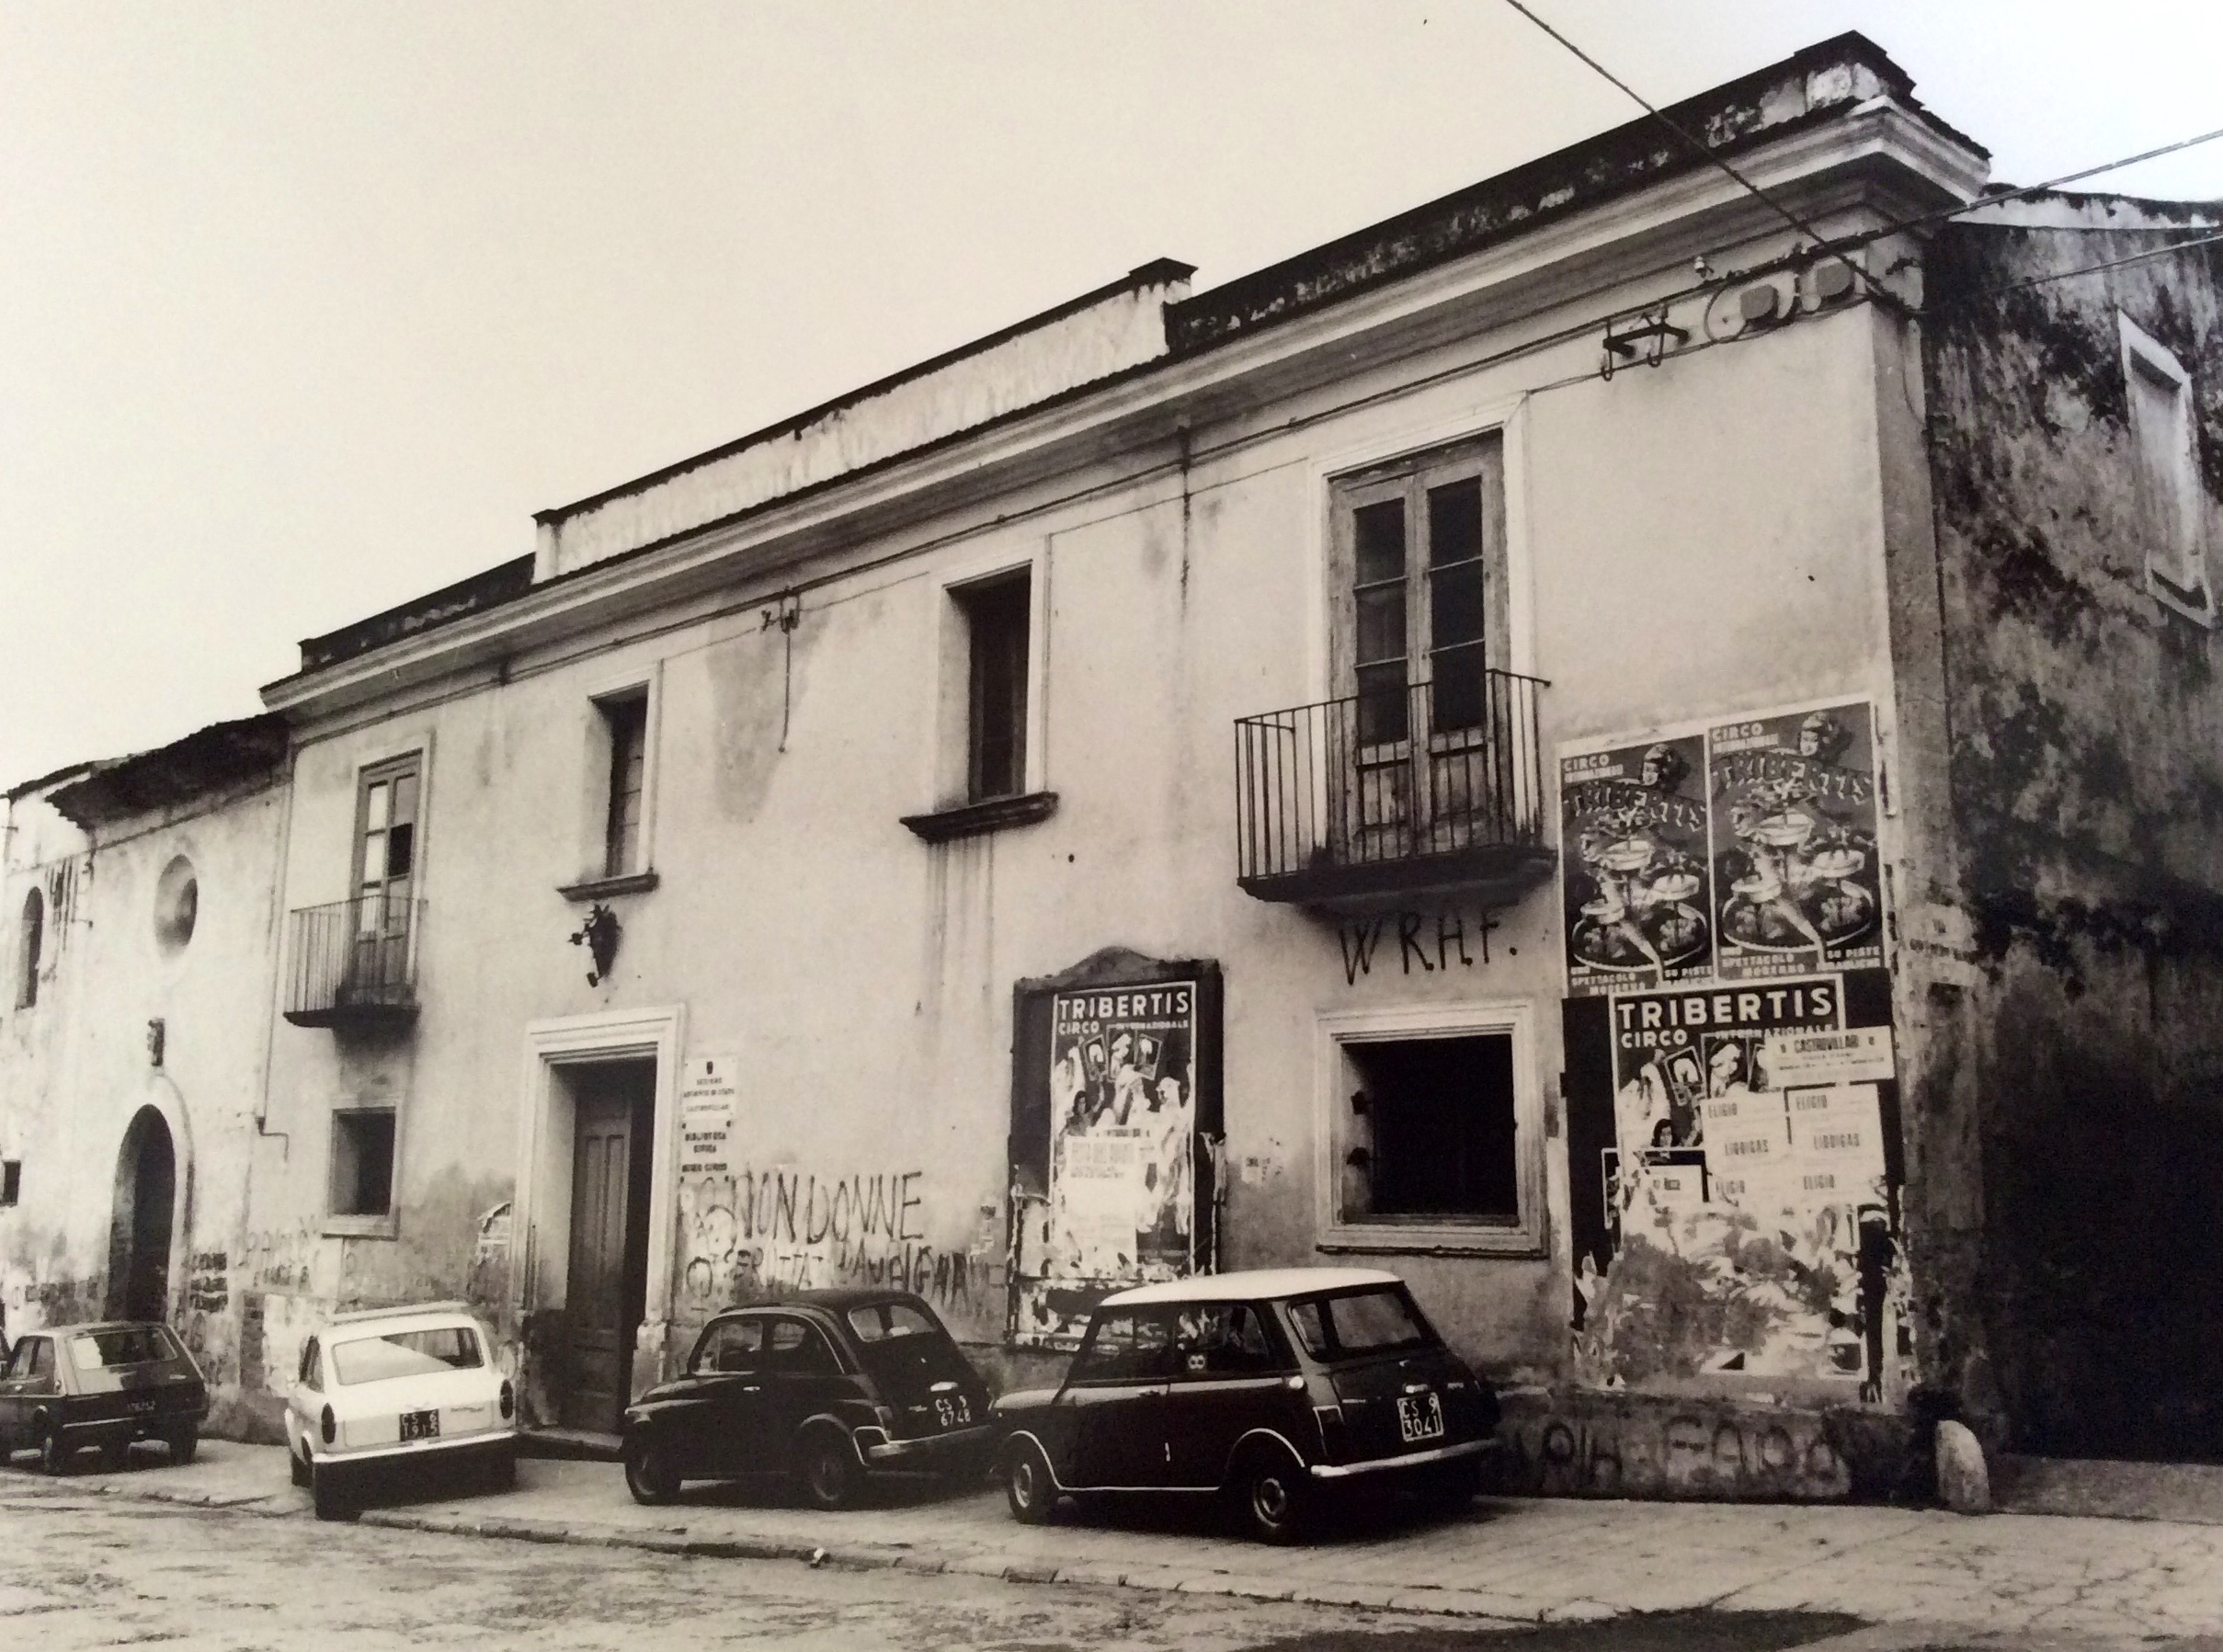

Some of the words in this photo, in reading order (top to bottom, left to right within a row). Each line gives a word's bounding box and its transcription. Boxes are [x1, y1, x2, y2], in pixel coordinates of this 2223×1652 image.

[1712, 723, 1762, 742] CIRCO
[1564, 754, 1610, 773] CIRCO
[1059, 991, 1190, 1020] TRIBERTIS
[1617, 987, 1833, 1030] TRIBERTIS
[1058, 1020, 1100, 1036] CIRCO
[1620, 1028, 1688, 1049] CIRCO
[935, 1397, 952, 1412] CS
[1401, 1399, 1419, 1418] CS
